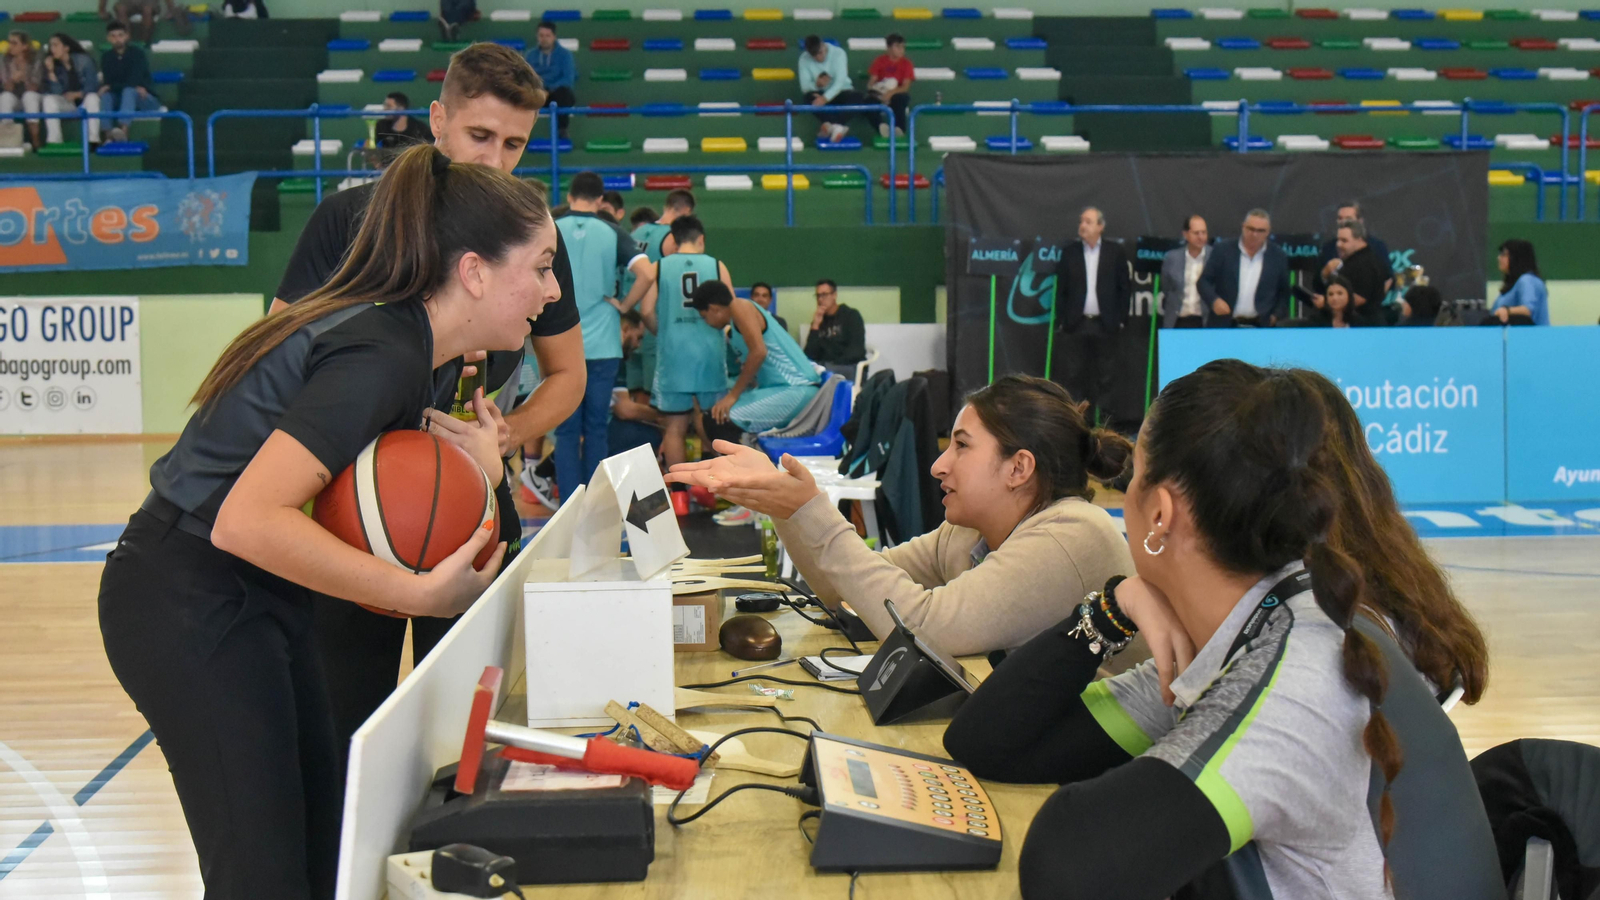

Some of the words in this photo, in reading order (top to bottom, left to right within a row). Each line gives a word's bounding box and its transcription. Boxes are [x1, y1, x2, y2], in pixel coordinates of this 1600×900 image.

[971, 248, 1019, 261] ALMERÍA
[1281, 242, 1318, 257] ÁLAGA
[41, 305, 134, 342] GROUP
[1337, 377, 1478, 409] putación
[1365, 422, 1449, 454] Cádiz
[1553, 465, 1600, 488] Ayun
